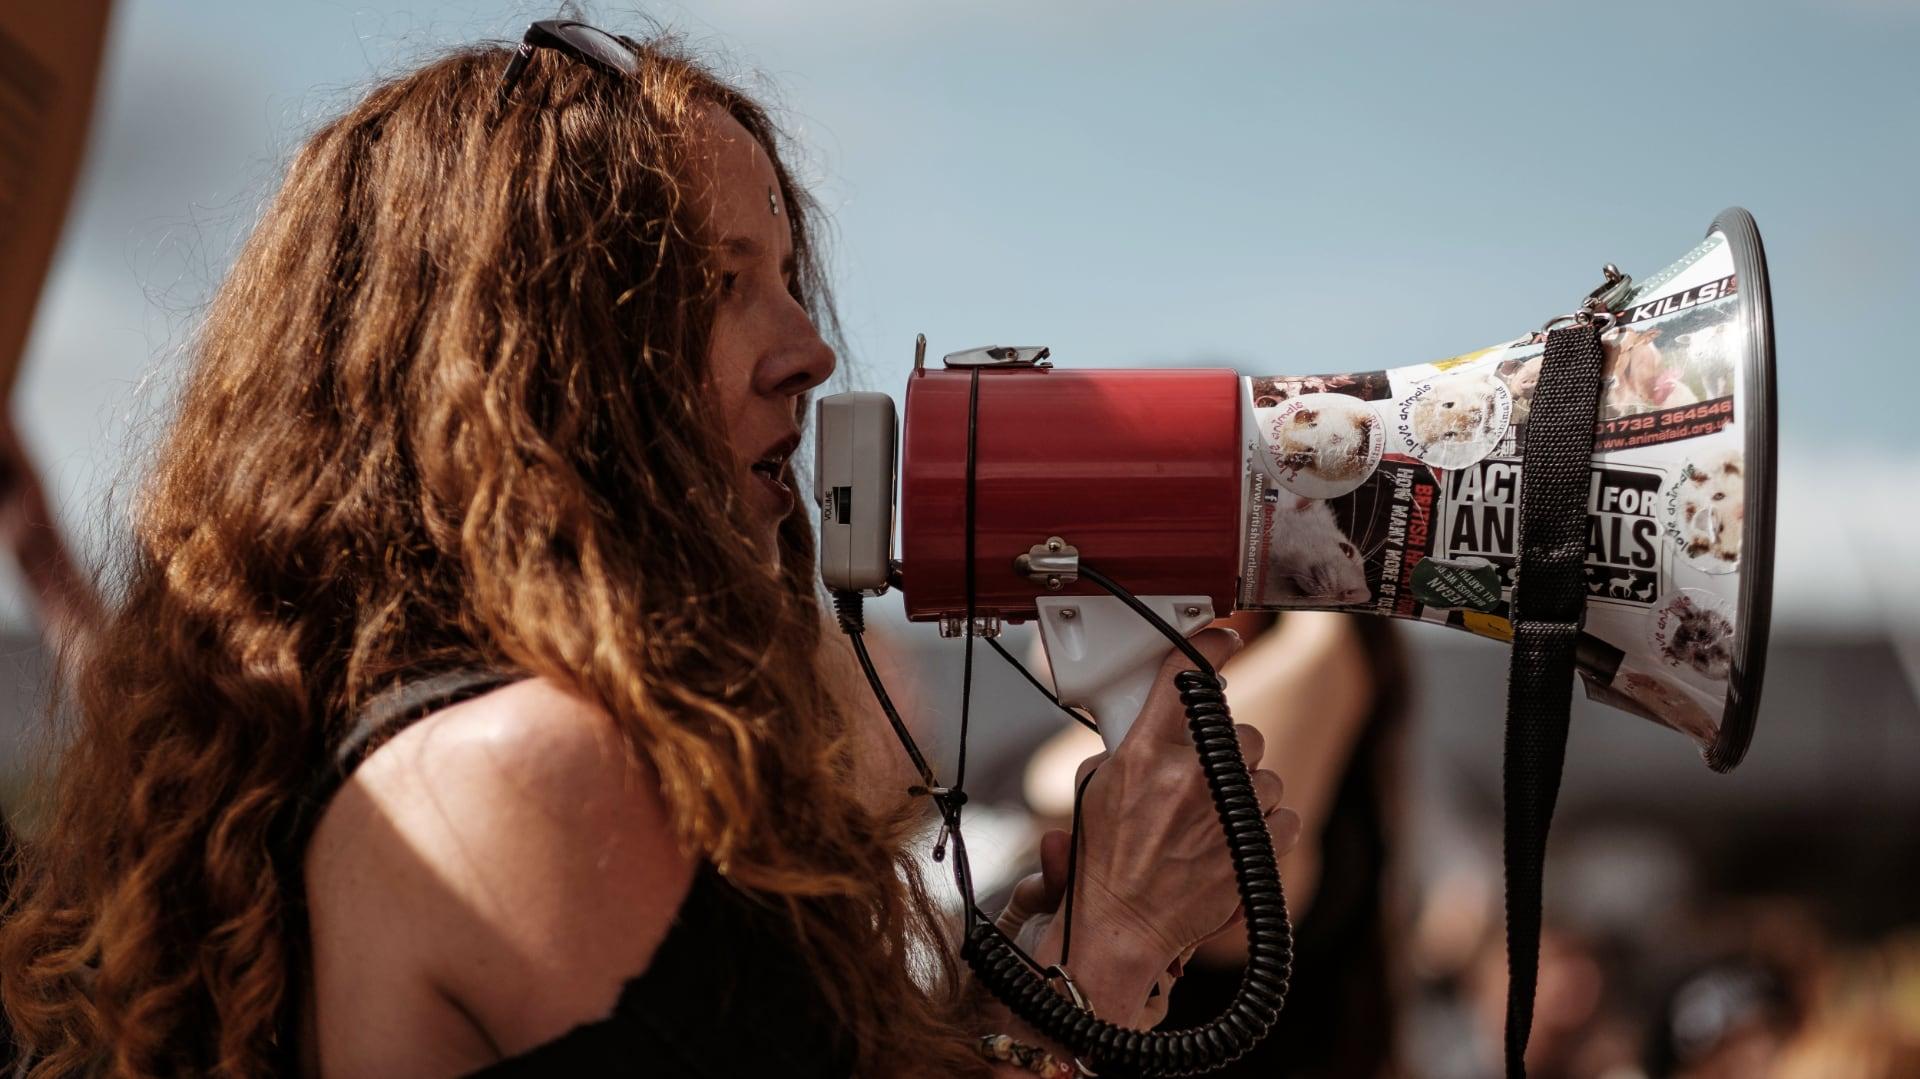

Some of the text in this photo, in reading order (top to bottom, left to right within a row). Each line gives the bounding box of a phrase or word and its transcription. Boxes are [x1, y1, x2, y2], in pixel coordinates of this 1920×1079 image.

[1631, 279, 1728, 323] KILLS!
[1401, 382, 1432, 421] animals
[1661, 400, 1732, 425] 364546
[1273, 401, 1305, 440] animals
[1398, 424, 1420, 453] love
[1394, 468, 1414, 501] HOW
[824, 491, 833, 521] VOLUME
[1408, 484, 1433, 545] BRITISH
[1602, 486, 1657, 517] FOR
[1388, 504, 1409, 547] MANY
[1449, 504, 1657, 569] ANALS
[1382, 549, 1403, 582] MORE
[1380, 583, 1397, 596] OF
[1427, 577, 1468, 605] VEGAN
[1482, 591, 1498, 602] ALL
